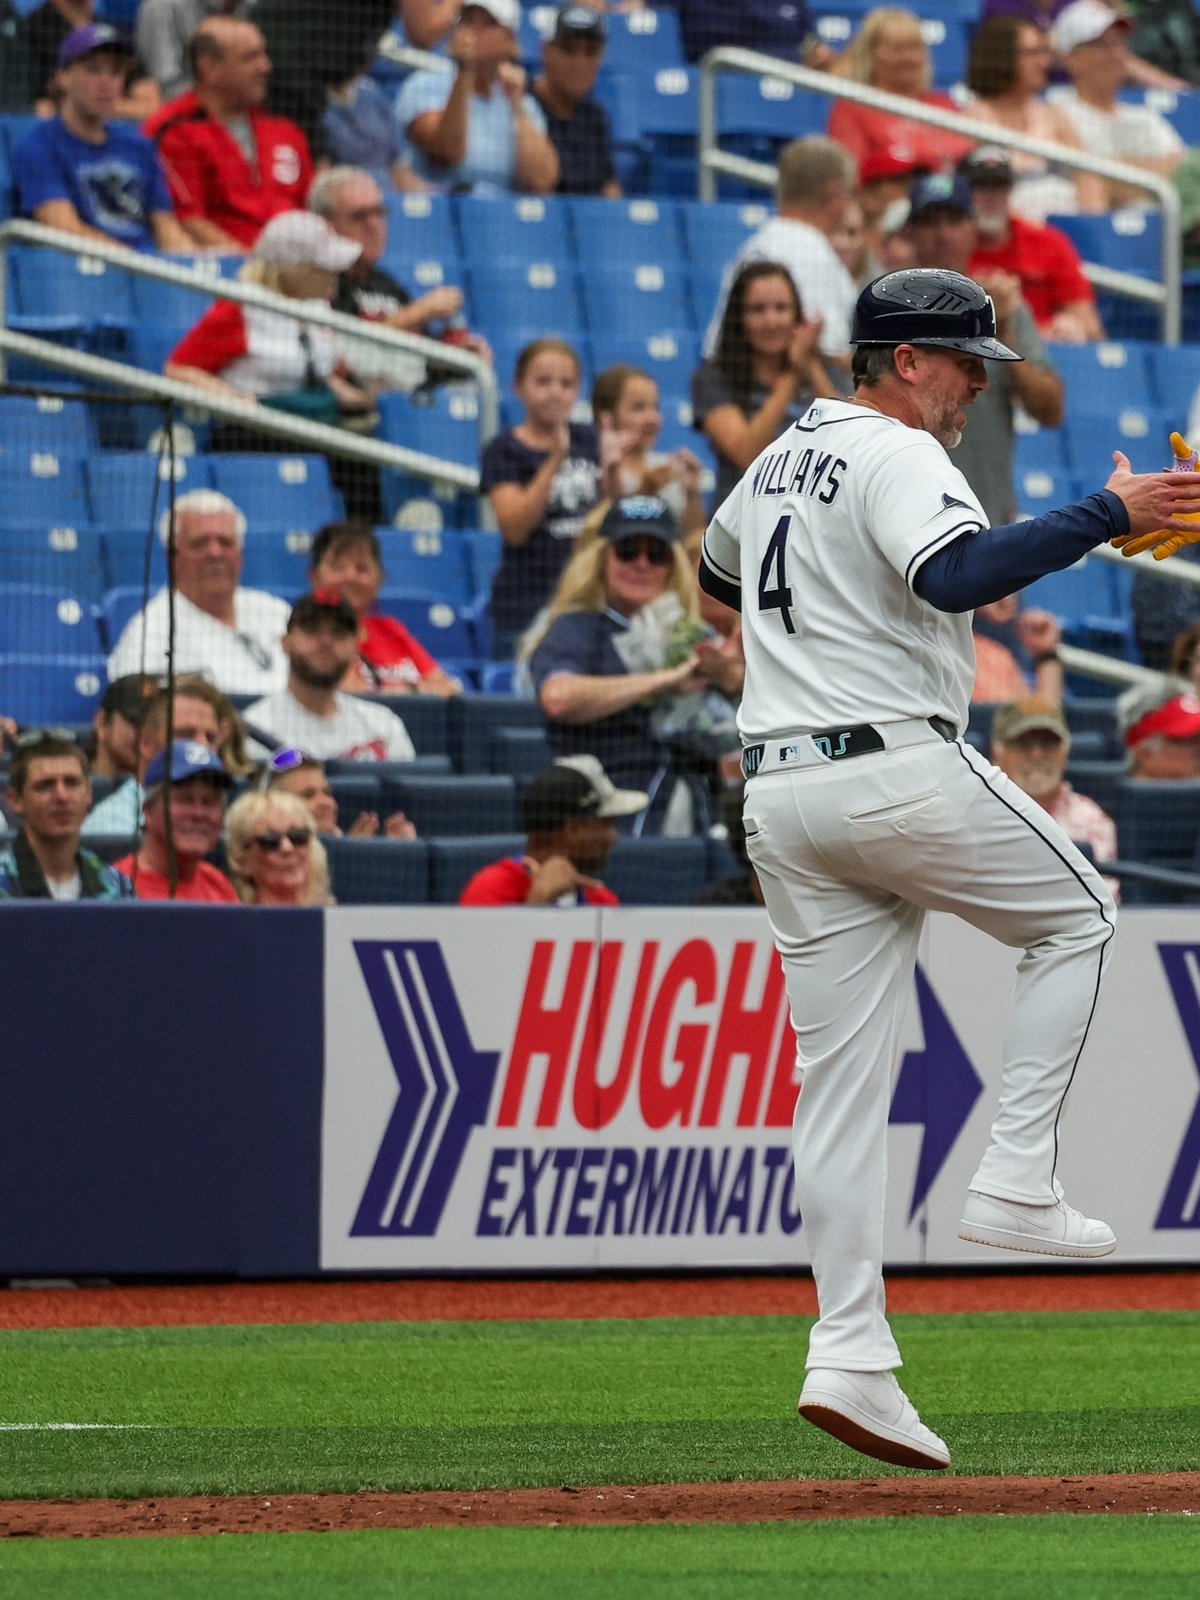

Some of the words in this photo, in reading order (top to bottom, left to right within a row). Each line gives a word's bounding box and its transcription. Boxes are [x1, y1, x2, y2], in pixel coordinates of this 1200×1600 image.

[752, 447, 848, 506] ILLAMS
[759, 514, 796, 636] 4
[496, 939, 803, 1130] HUGH
[475, 1146, 802, 1236] EXTERMINAT
